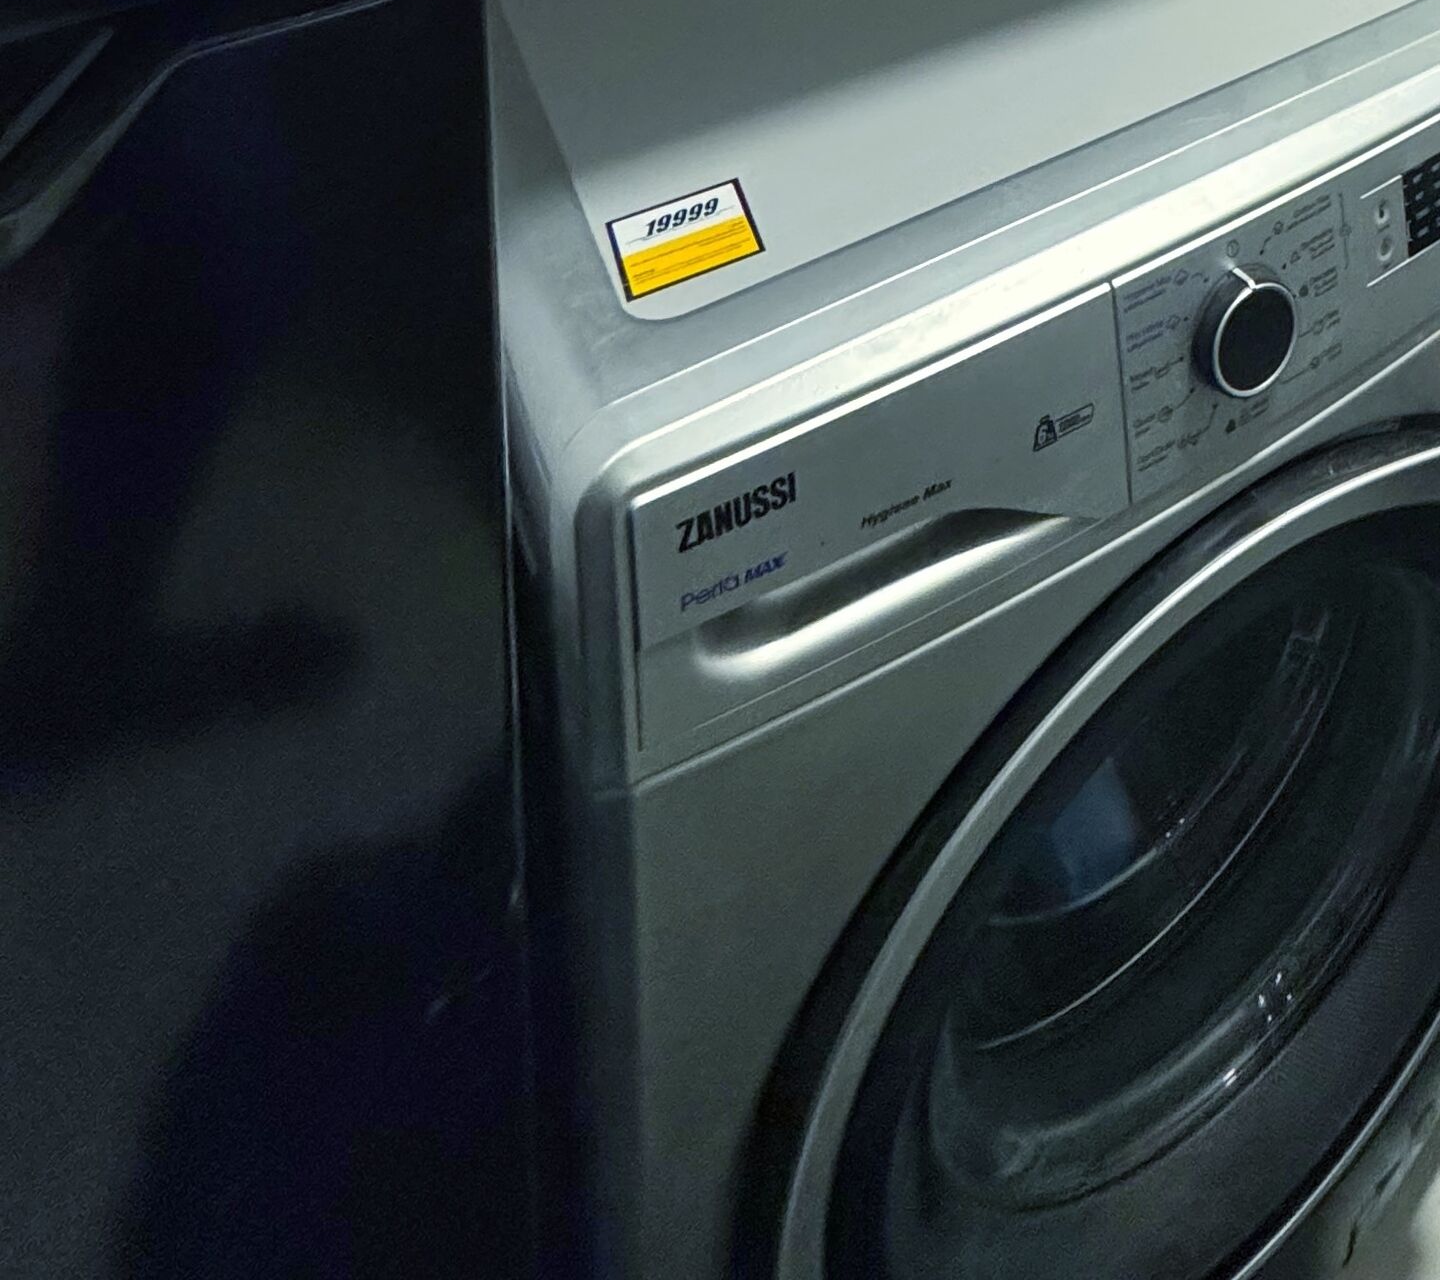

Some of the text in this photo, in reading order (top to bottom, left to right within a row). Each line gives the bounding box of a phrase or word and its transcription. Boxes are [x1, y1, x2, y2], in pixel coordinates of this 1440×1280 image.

[646, 197, 719, 237] 19999
[922, 479, 953, 502] Max
[675, 470, 797, 554] ZANUSSI
